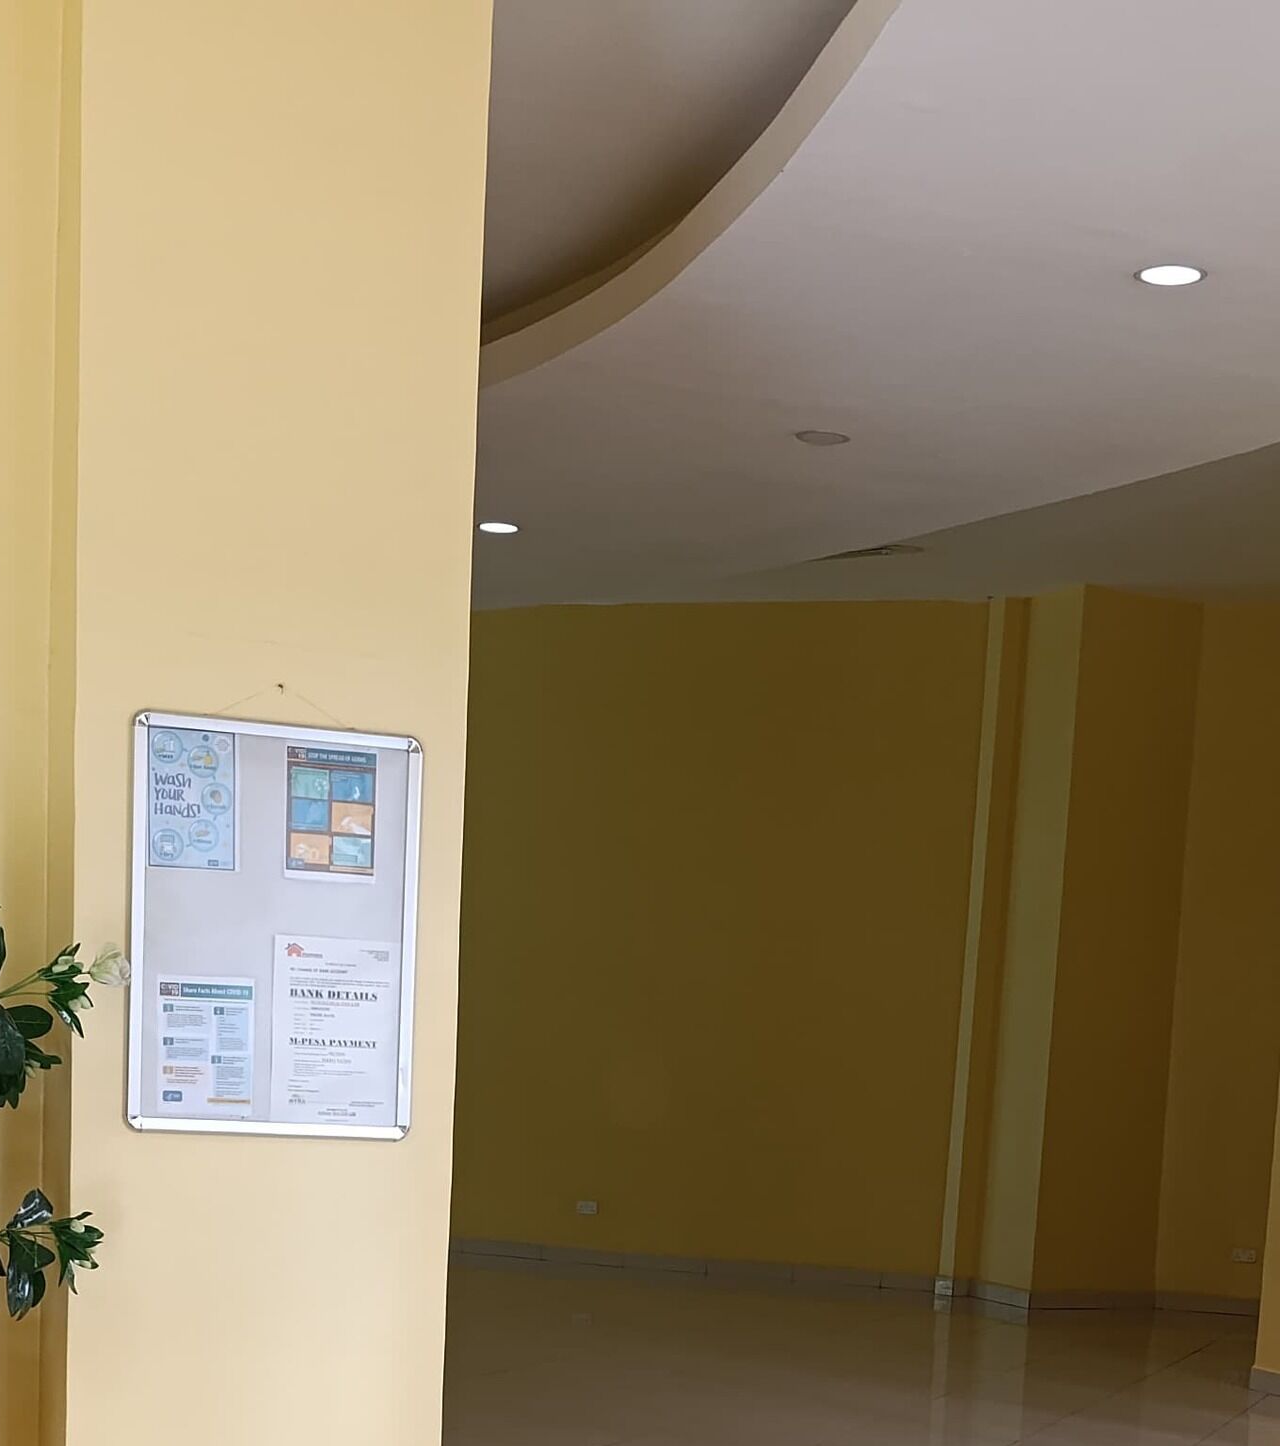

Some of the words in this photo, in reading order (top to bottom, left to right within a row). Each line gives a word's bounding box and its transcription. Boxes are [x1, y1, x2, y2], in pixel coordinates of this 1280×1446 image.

[154, 786, 186, 801] YOUR
[290, 988, 324, 999] BANK
[327, 990, 378, 1001] DETAILS
[289, 1037, 326, 1046] M-PESA
[329, 1039, 377, 1049] PAYMENT
